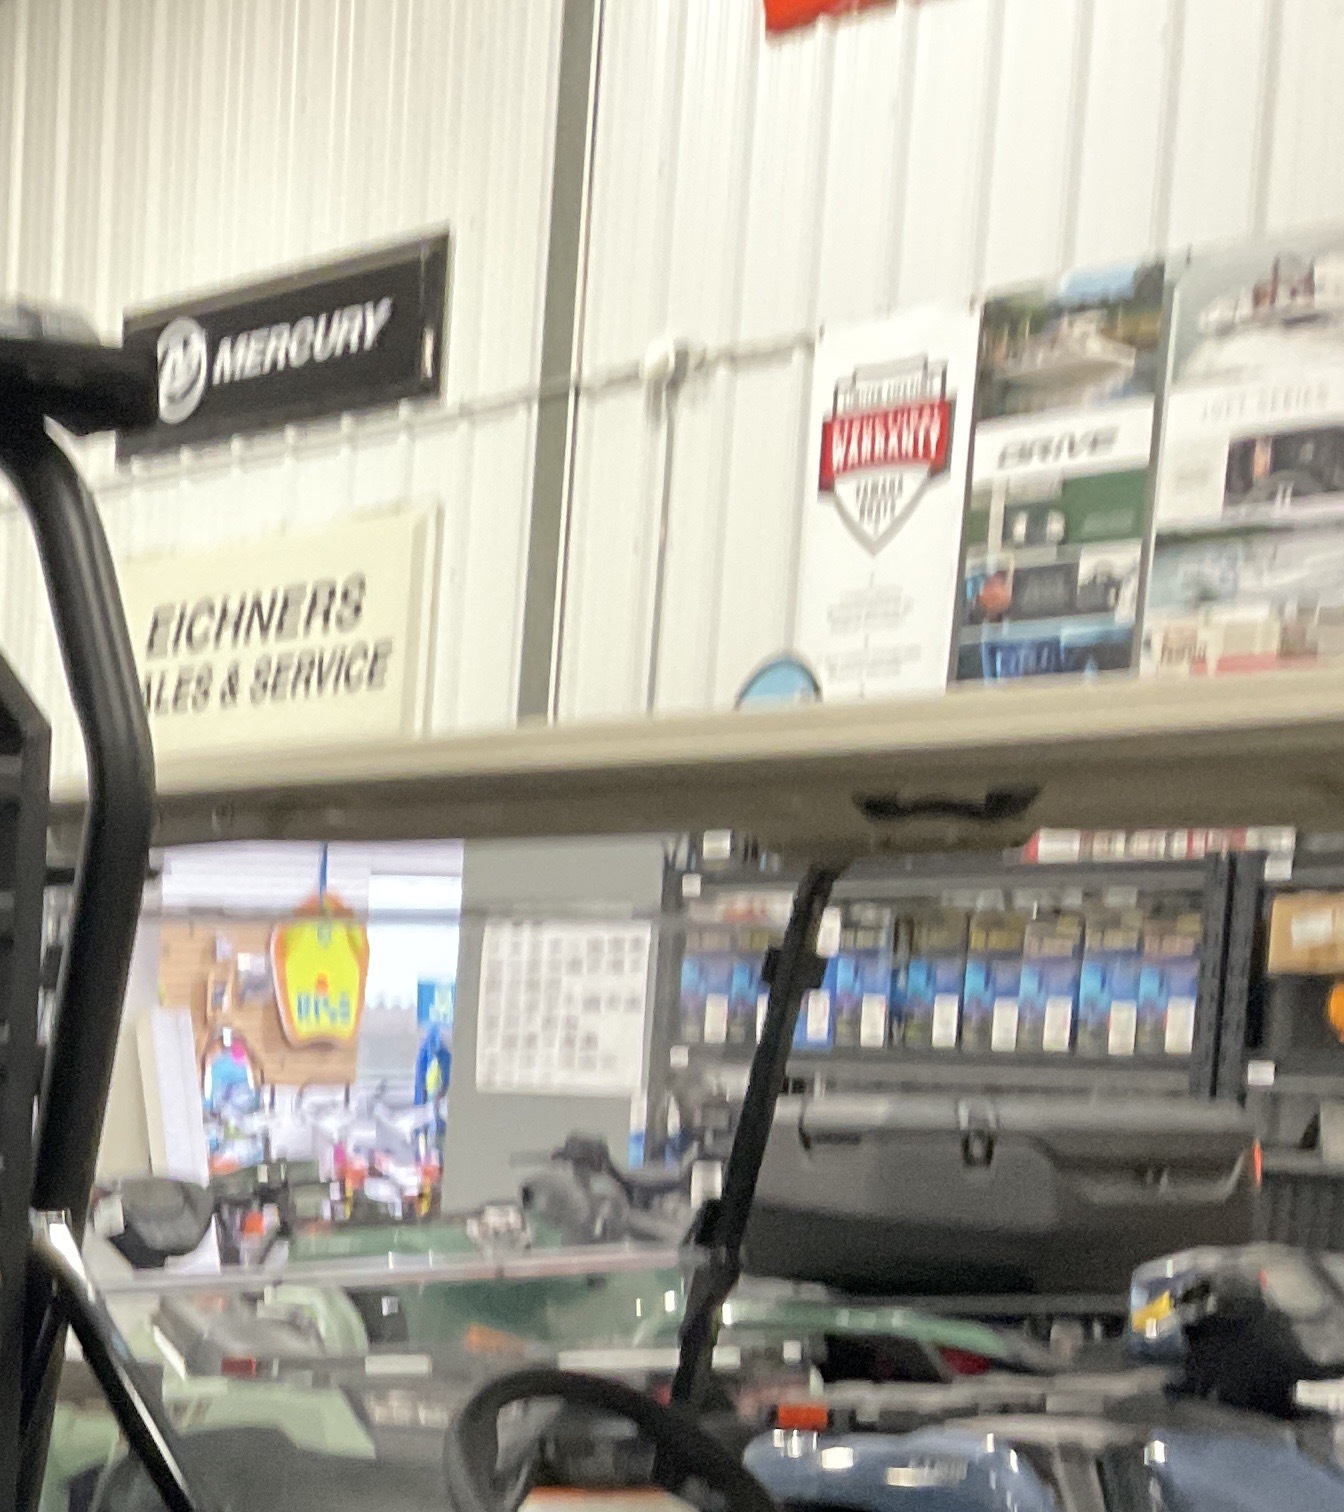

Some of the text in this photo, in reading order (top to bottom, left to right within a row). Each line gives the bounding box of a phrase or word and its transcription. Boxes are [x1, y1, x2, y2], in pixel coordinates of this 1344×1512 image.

[213, 297, 393, 386] MERCURY
[146, 570, 367, 660] EICHNERS
[219, 658, 241, 711] &
[250, 637, 393, 706] SERVICE
